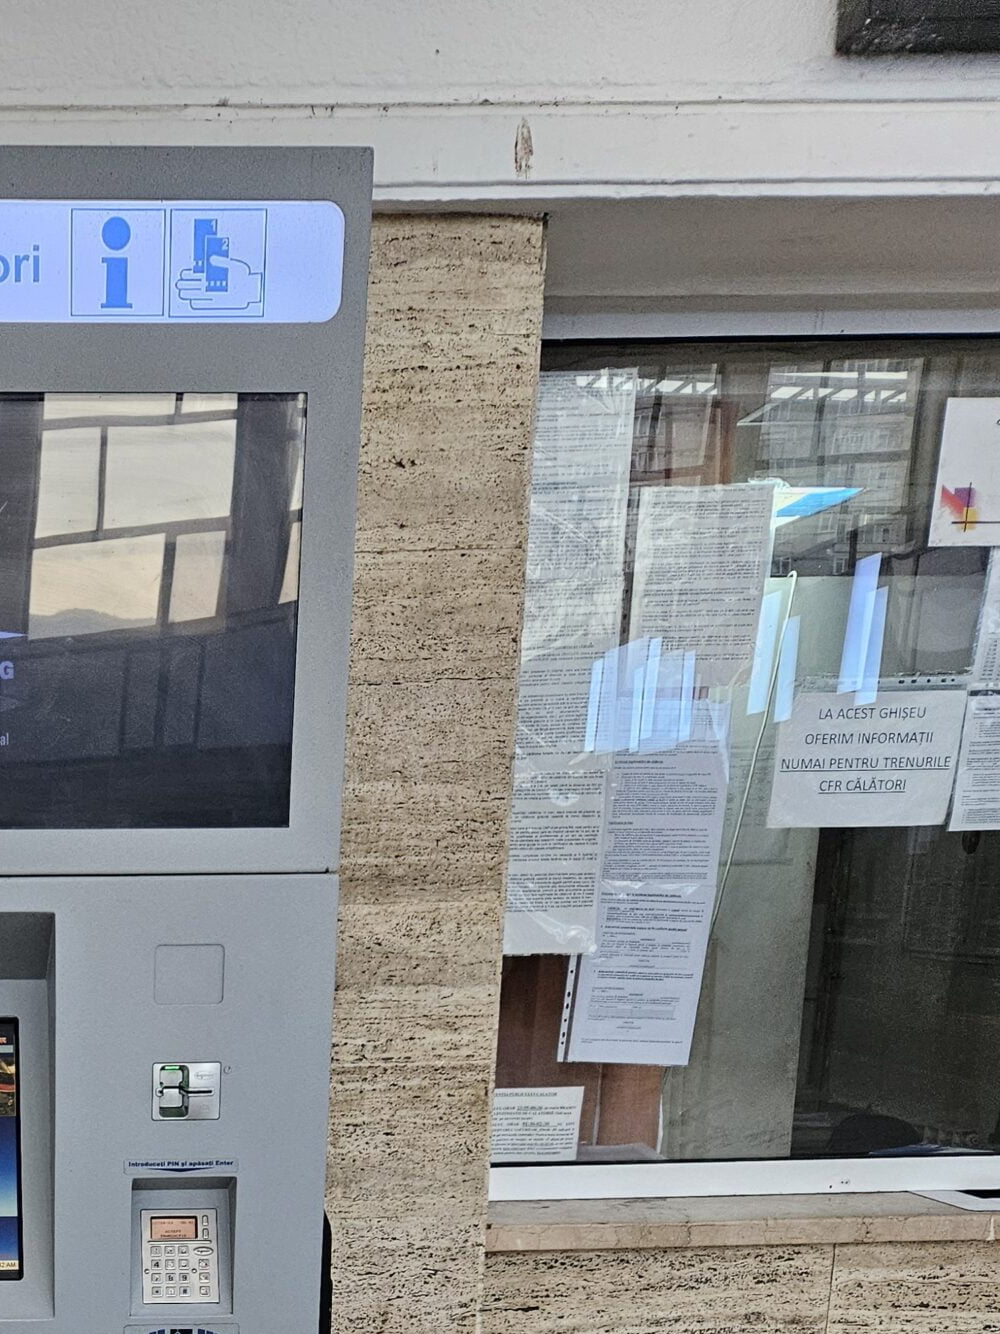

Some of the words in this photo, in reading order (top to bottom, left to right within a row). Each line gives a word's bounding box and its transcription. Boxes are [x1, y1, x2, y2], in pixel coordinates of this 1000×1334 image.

[818, 707, 833, 720] LA
[837, 707, 877, 720] ACEST
[879, 706, 927, 721] GHIȘEU
[804, 732, 854, 745] OFERIM
[857, 731, 934, 747] INFORMAȚII
[780, 758, 826, 770] NUMAI
[829, 757, 879, 770] PENTRU
[883, 755, 951, 769] TRENURILE
[818, 780, 842, 792] CFR
[846, 776, 907, 792] CĂLĂTORI
